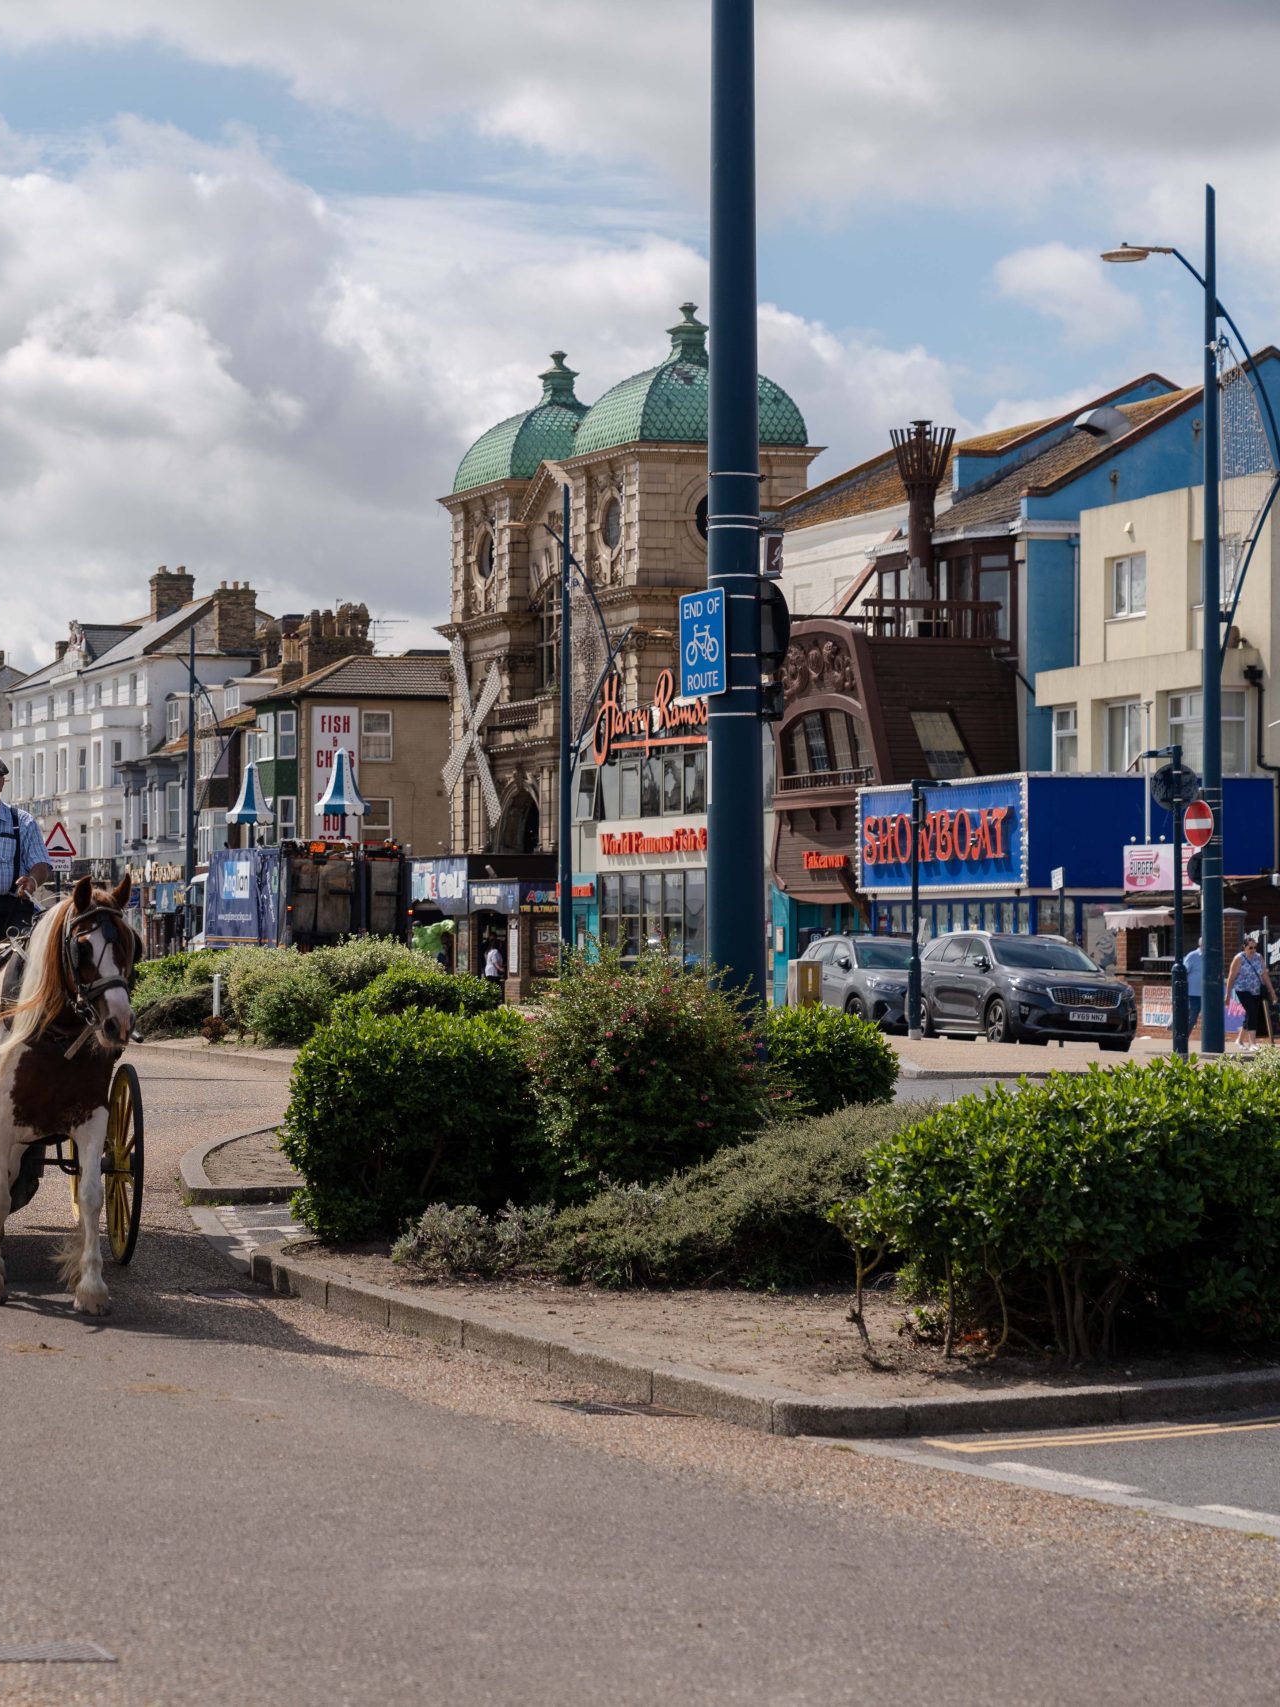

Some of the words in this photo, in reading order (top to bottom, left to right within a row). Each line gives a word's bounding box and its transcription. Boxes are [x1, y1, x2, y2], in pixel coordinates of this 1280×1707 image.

[683, 601, 703, 619] END
[706, 597, 720, 615] OF
[687, 671, 719, 691] ROUTE
[321, 715, 350, 733] FISH
[593, 674, 650, 766] Harry
[600, 833, 631, 855] World
[632, 832, 676, 853] Famous
[674, 827, 697, 851] Fish
[697, 827, 708, 851] &
[802, 851, 846, 869] Takeaway
[1129, 860, 1154, 876] BURGER
[224, 868, 248, 897] Anglian
